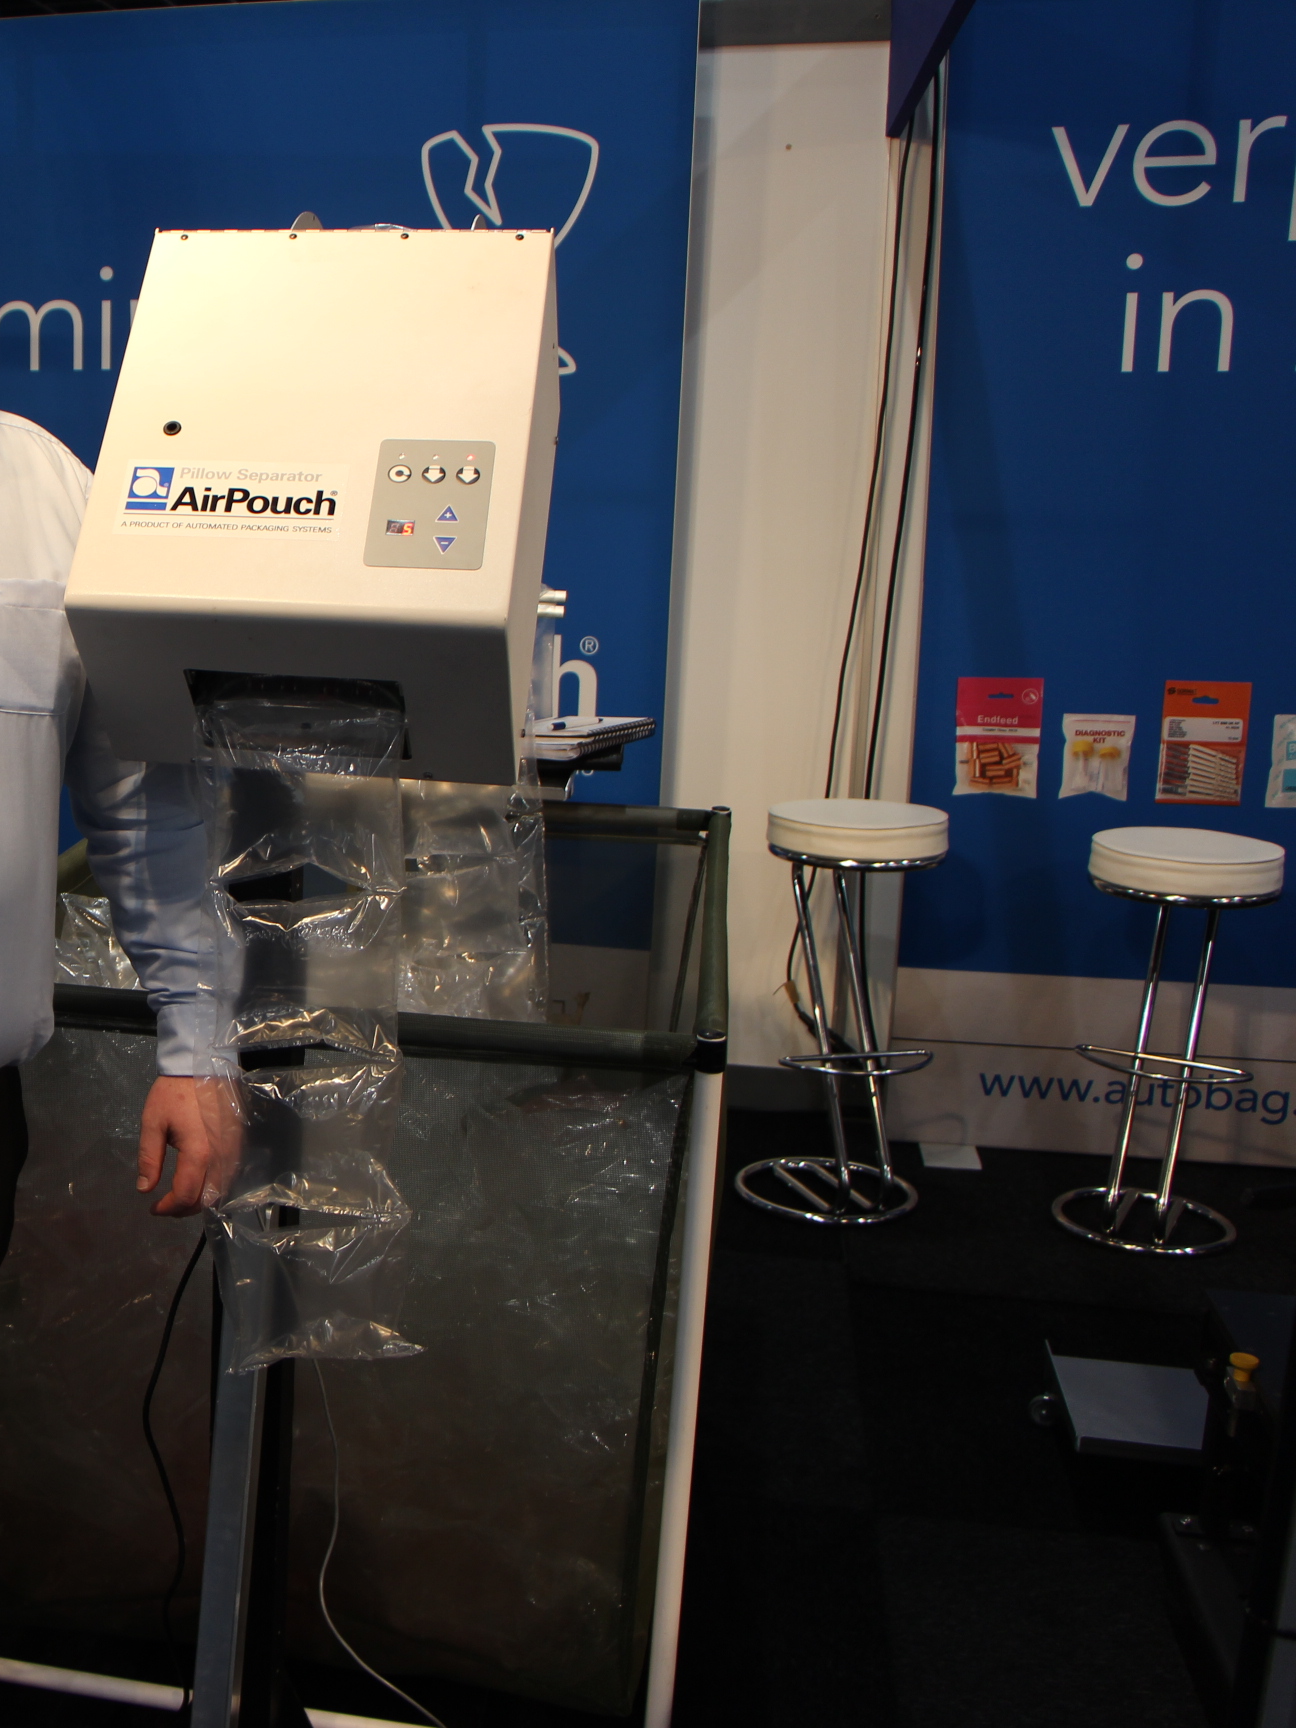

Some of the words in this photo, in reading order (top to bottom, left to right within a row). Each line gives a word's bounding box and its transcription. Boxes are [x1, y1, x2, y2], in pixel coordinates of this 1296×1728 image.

[1051, 115, 1296, 241] ver
[1121, 252, 1235, 373] in
[179, 467, 232, 481] Pillow
[237, 468, 322, 484] Separator
[129, 521, 170, 529] PRODUCT
[185, 522, 239, 531] AUTOMATED
[240, 524, 290, 533] PACKAGING
[292, 525, 333, 534] SYSTEMS
[977, 715, 1019, 725] Endfeed
[1074, 729, 1126, 737] DIAGNOSTIC
